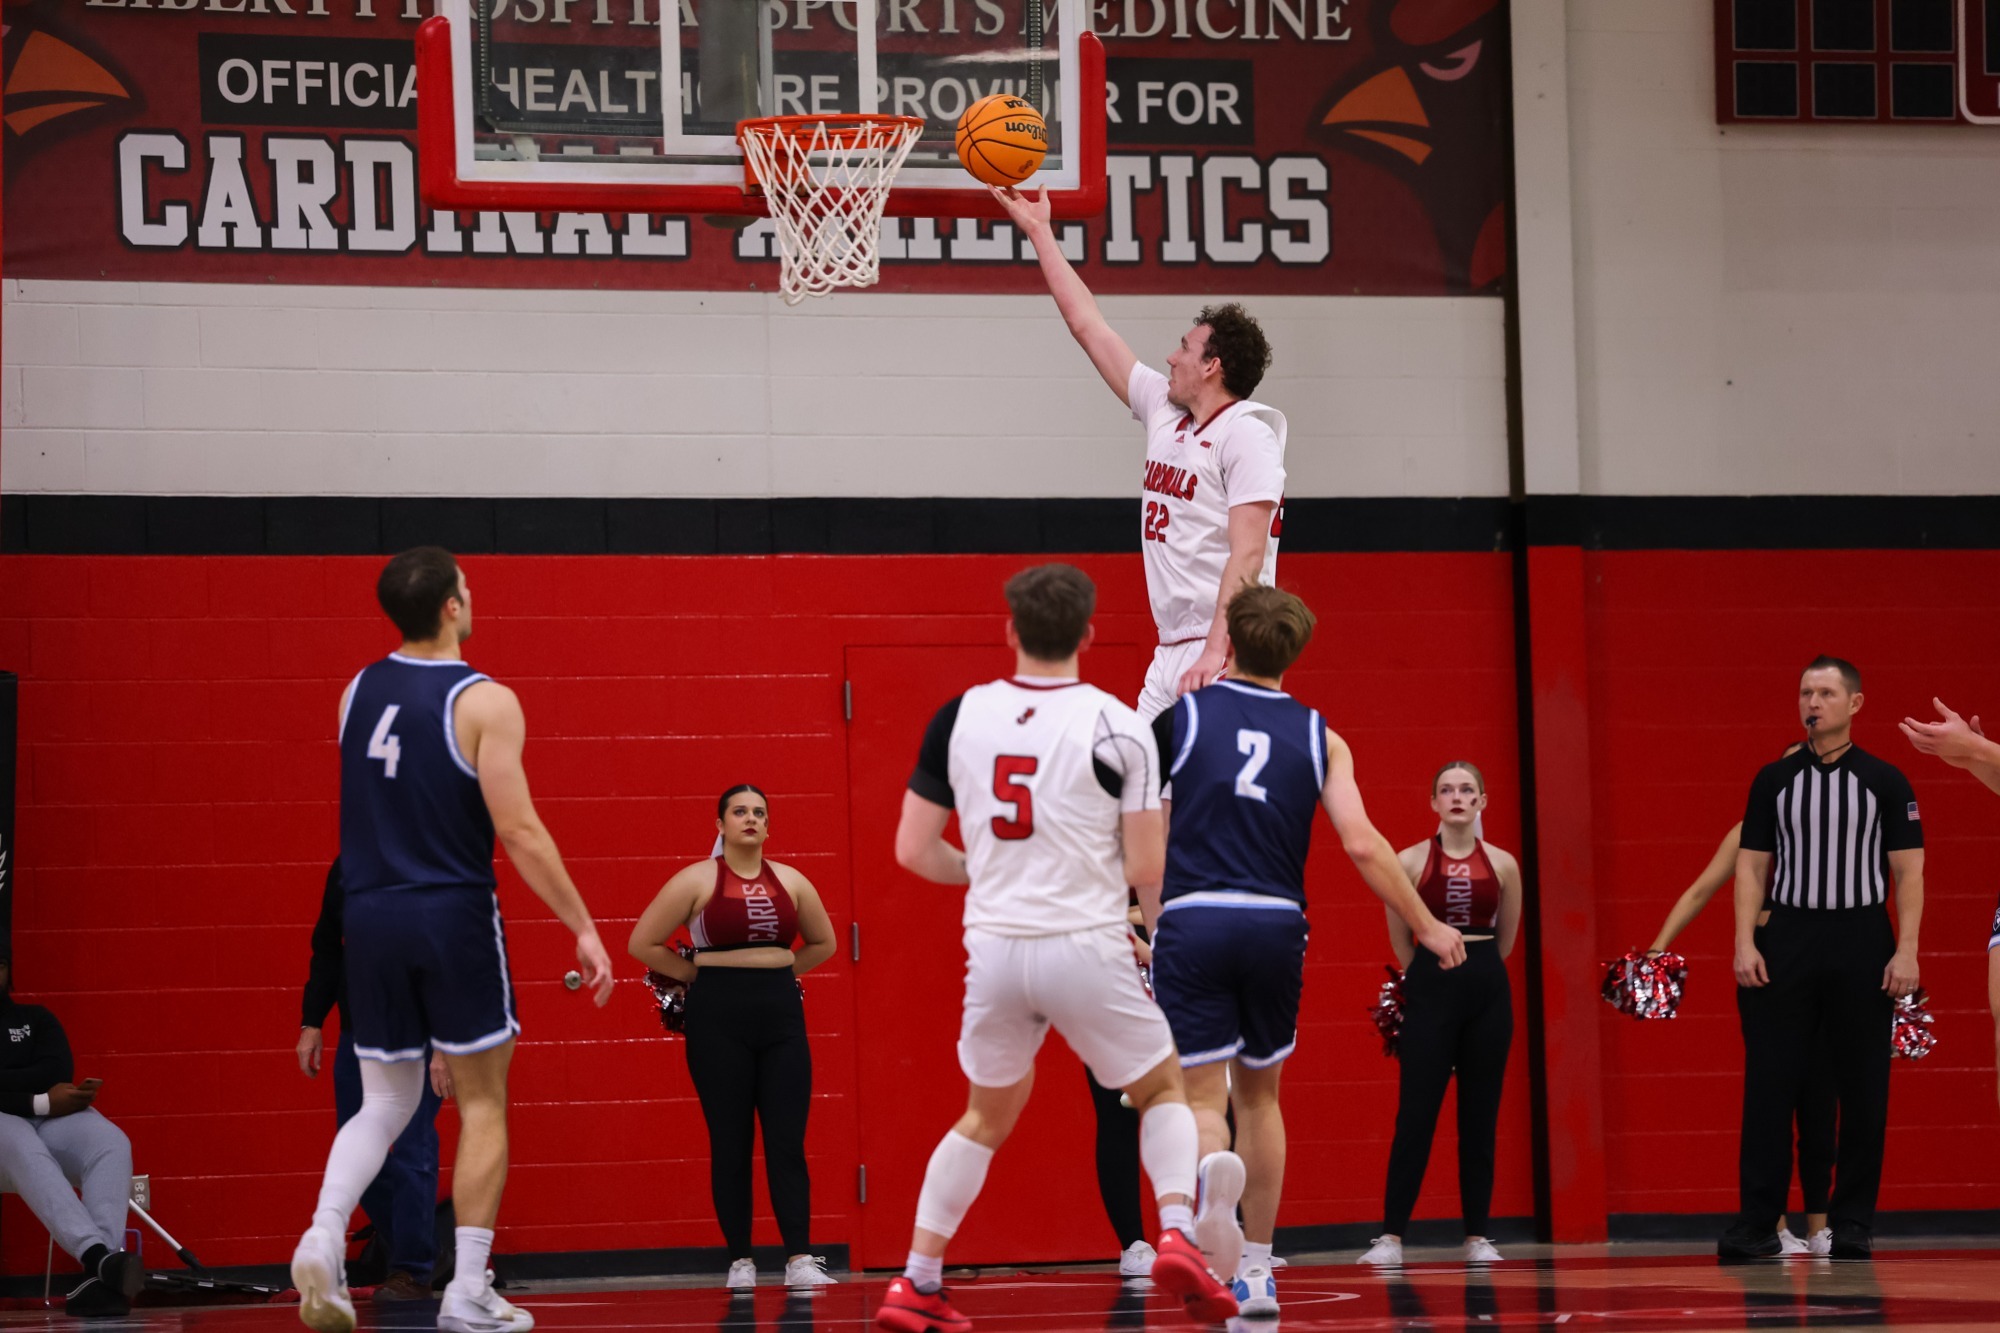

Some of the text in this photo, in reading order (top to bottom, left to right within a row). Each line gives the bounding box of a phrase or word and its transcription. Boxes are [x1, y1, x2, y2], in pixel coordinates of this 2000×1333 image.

[217, 58, 418, 108] OFFICI
[491, 66, 842, 115] HEALTRE
[1138, 81, 1242, 125] FOR
[1145, 501, 1169, 543] 22
[367, 704, 401, 778] 4
[1235, 728, 1271, 803] 2
[991, 754, 1038, 841] 5
[742, 883, 779, 942] CARDS
[1446, 863, 1472, 927] CARDS
